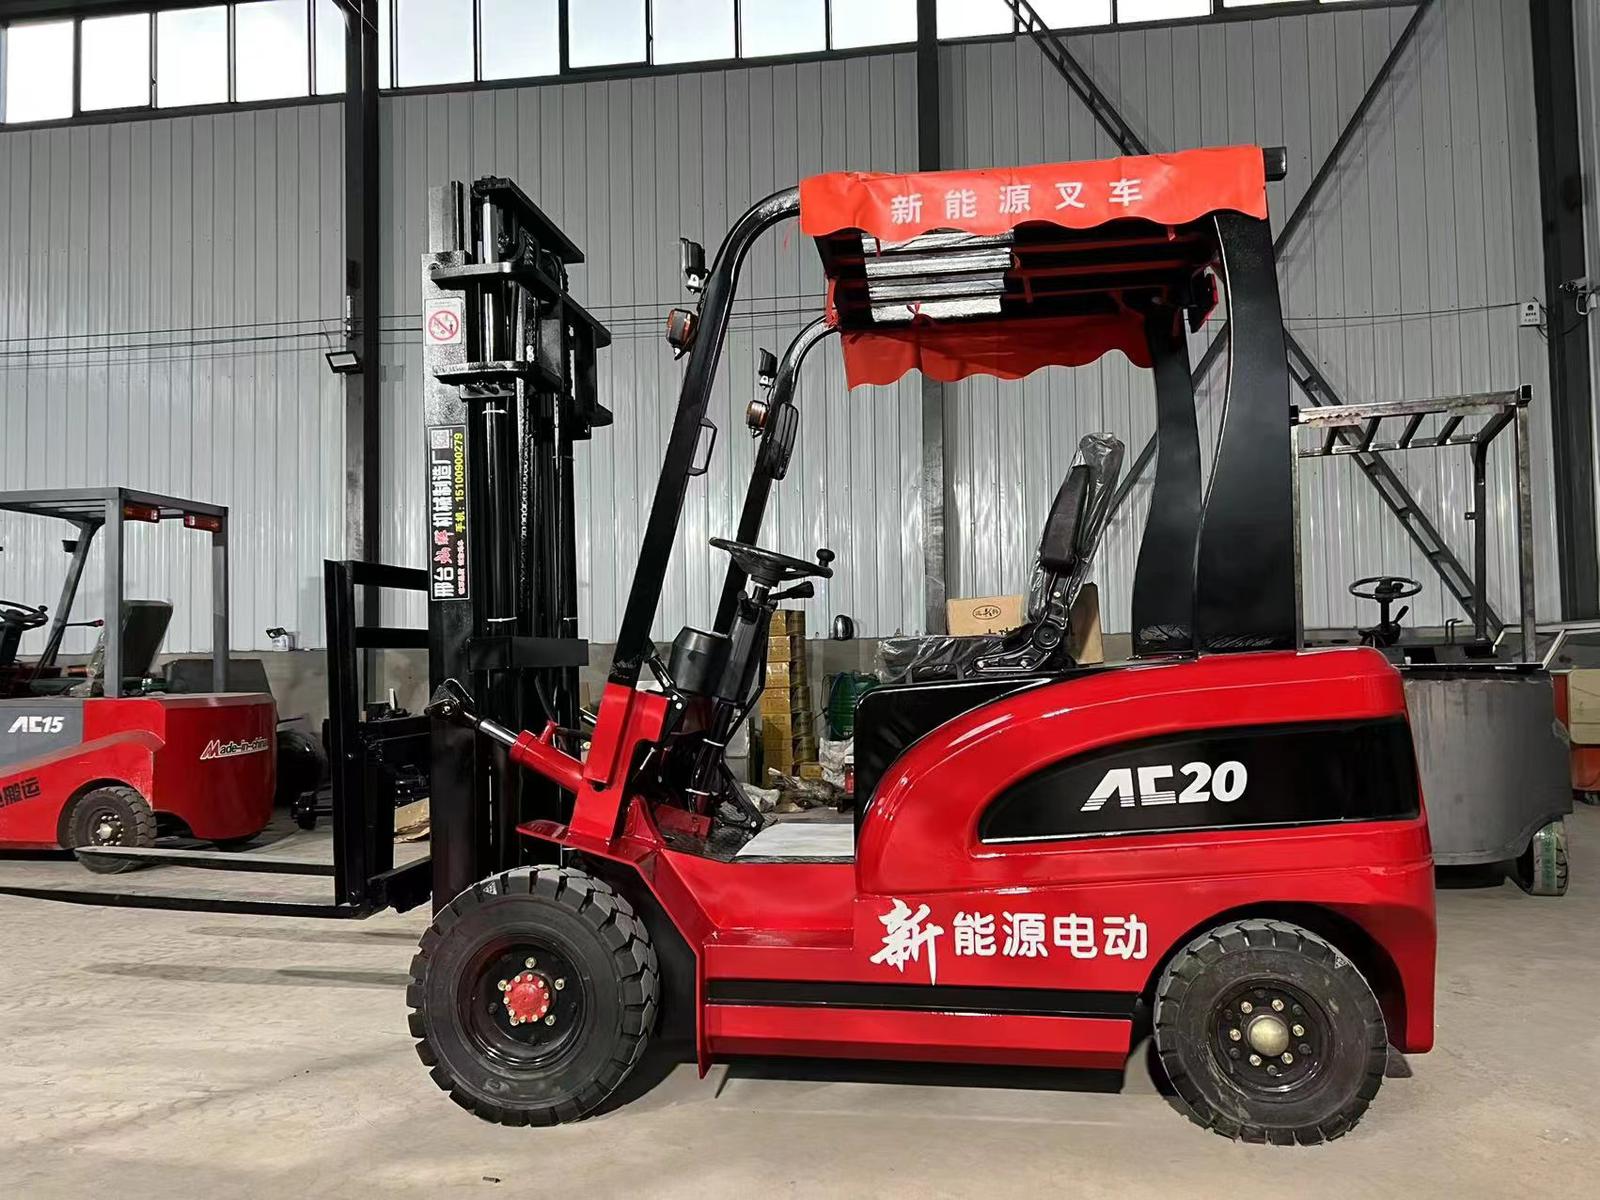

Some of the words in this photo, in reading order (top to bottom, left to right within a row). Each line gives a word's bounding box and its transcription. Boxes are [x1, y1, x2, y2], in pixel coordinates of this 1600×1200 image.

[890, 177, 1143, 225] 新能源叉车
[8, 716, 65, 733] AC15
[0, 777, 41, 809] 搬运
[1080, 760, 1249, 812] AC20
[869, 897, 1149, 986] 新能源电动
